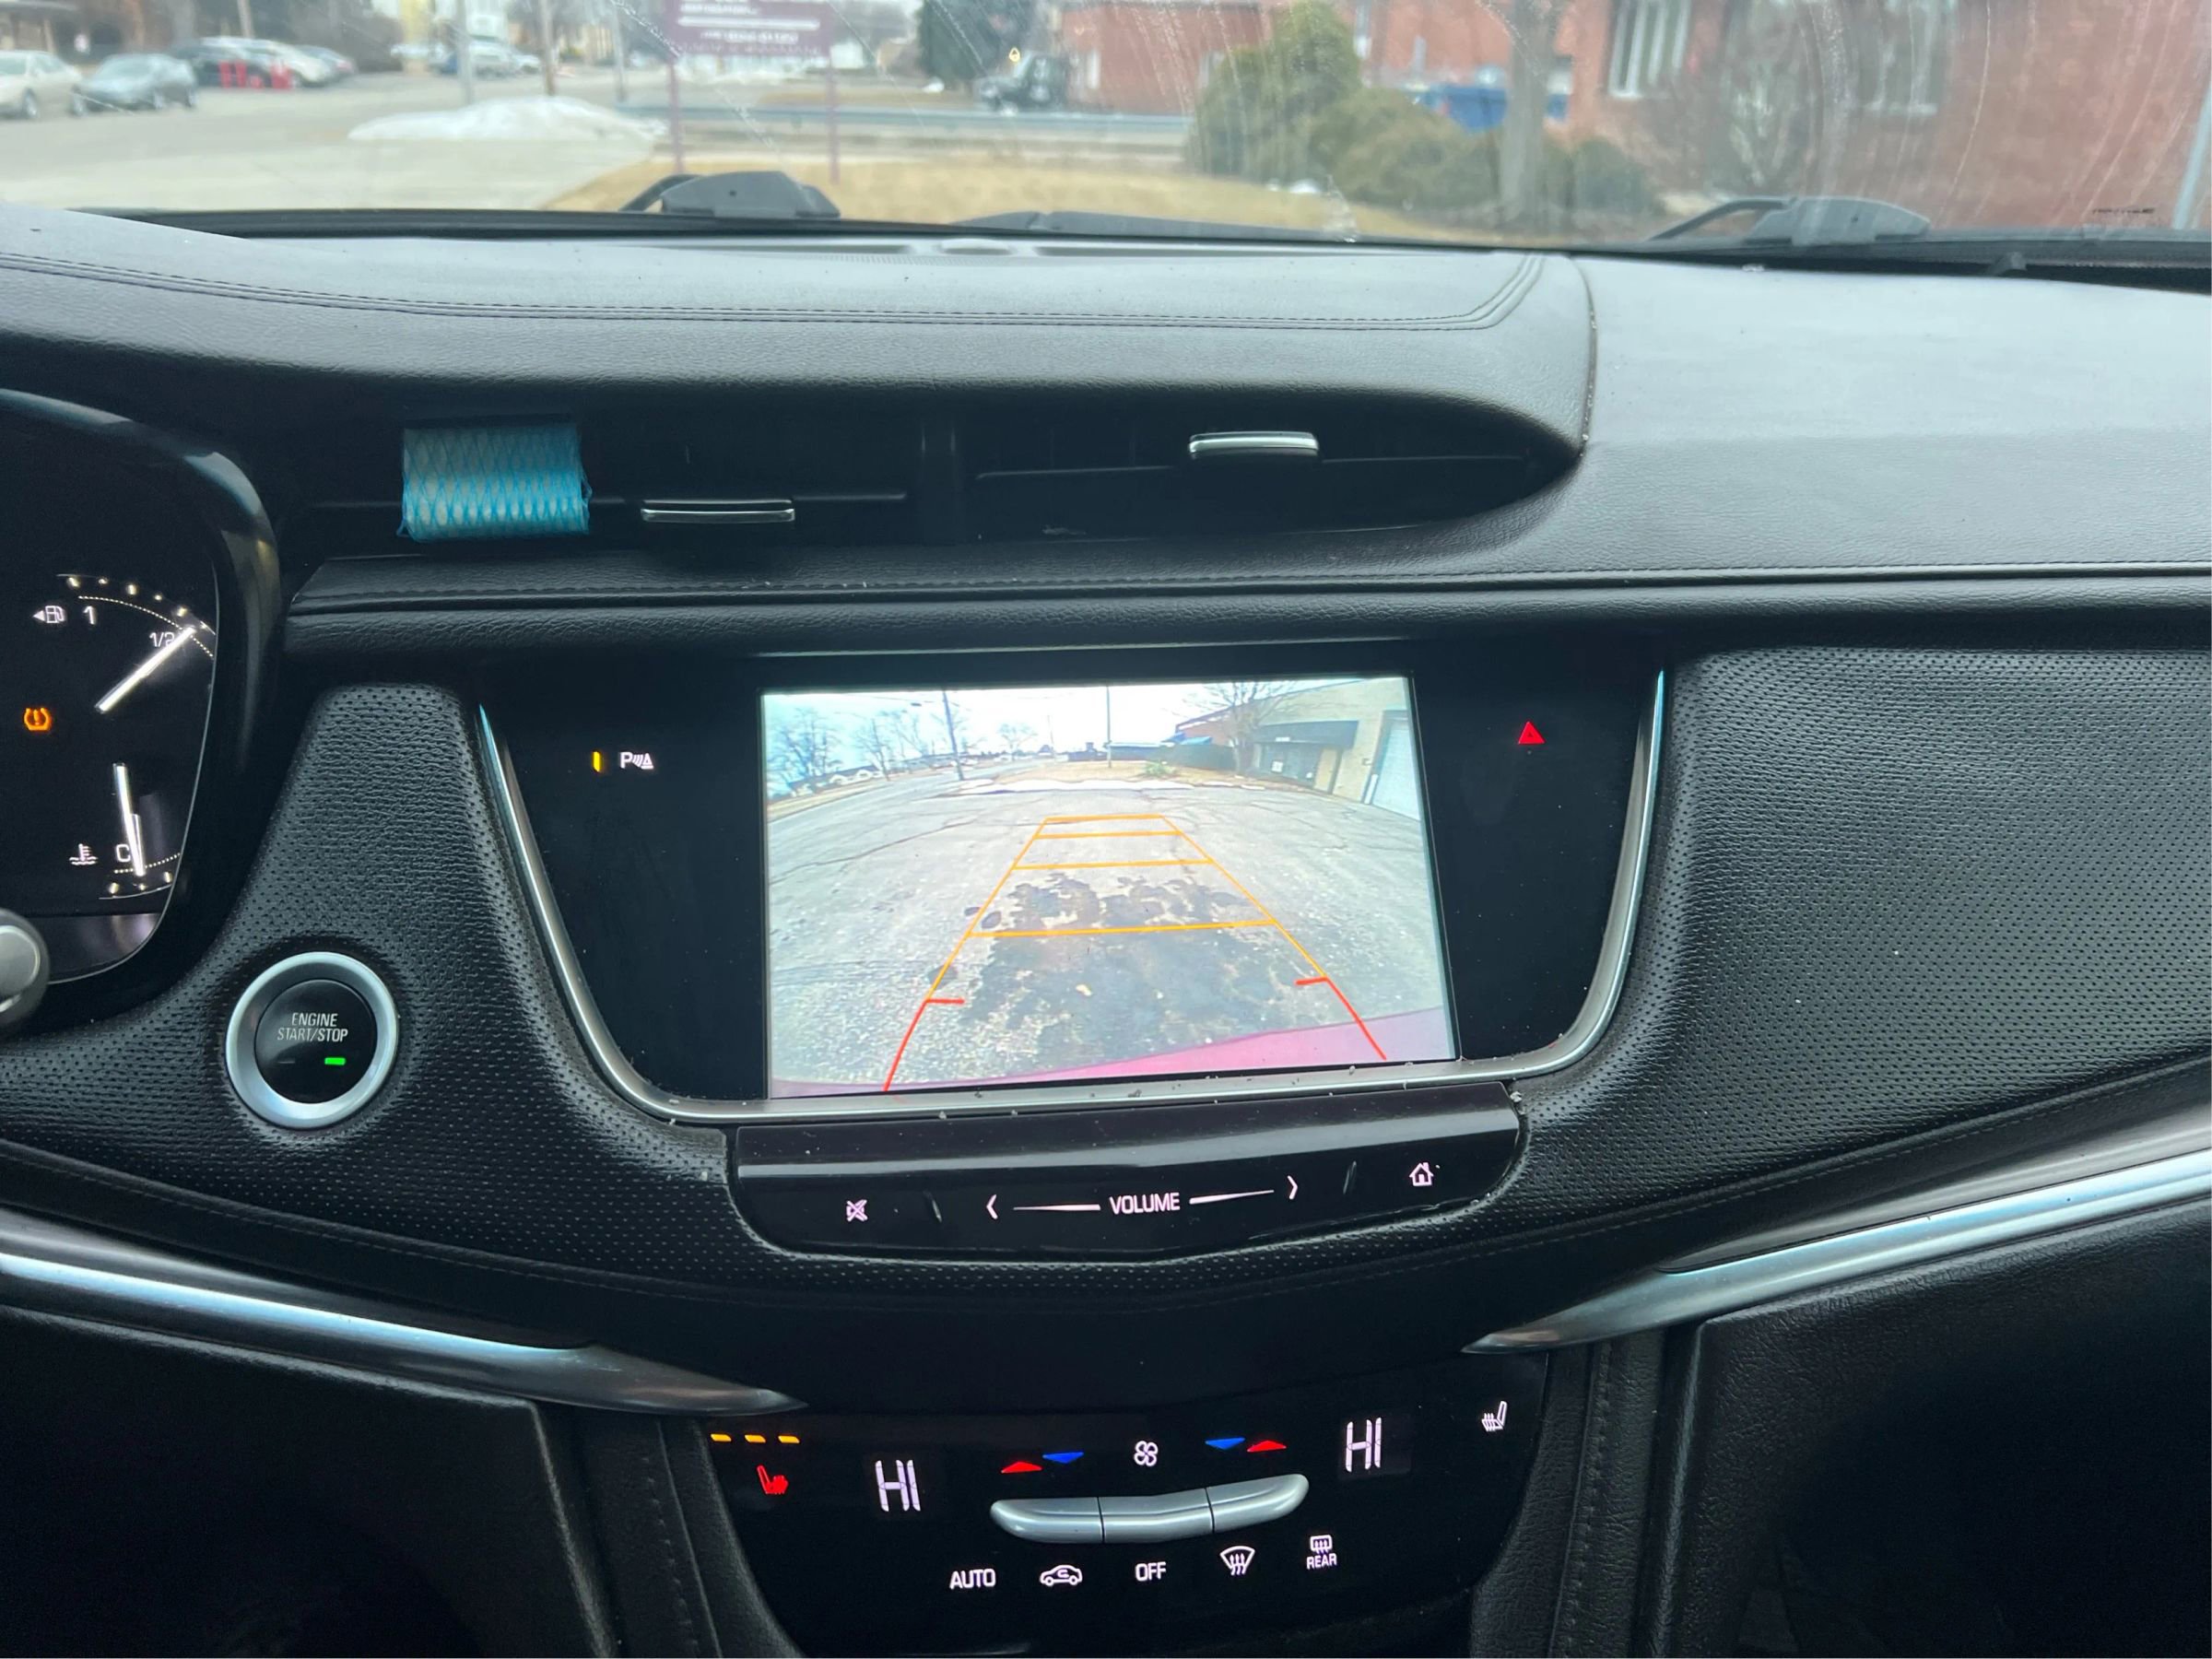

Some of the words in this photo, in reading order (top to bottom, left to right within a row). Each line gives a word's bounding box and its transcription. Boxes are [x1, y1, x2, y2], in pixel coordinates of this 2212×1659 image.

[83, 606, 96, 625] 1
[291, 1012, 338, 1028] ENGINE
[276, 1027, 348, 1042] START/STOP
[1109, 1192, 1181, 1215] VOLUME
[1346, 1417, 1383, 1473] HI
[875, 1459, 921, 1512] HI
[1135, 1561, 1167, 1582] OFF
[1306, 1554, 1337, 1570] REAR
[949, 1568, 996, 1590] AUTO
